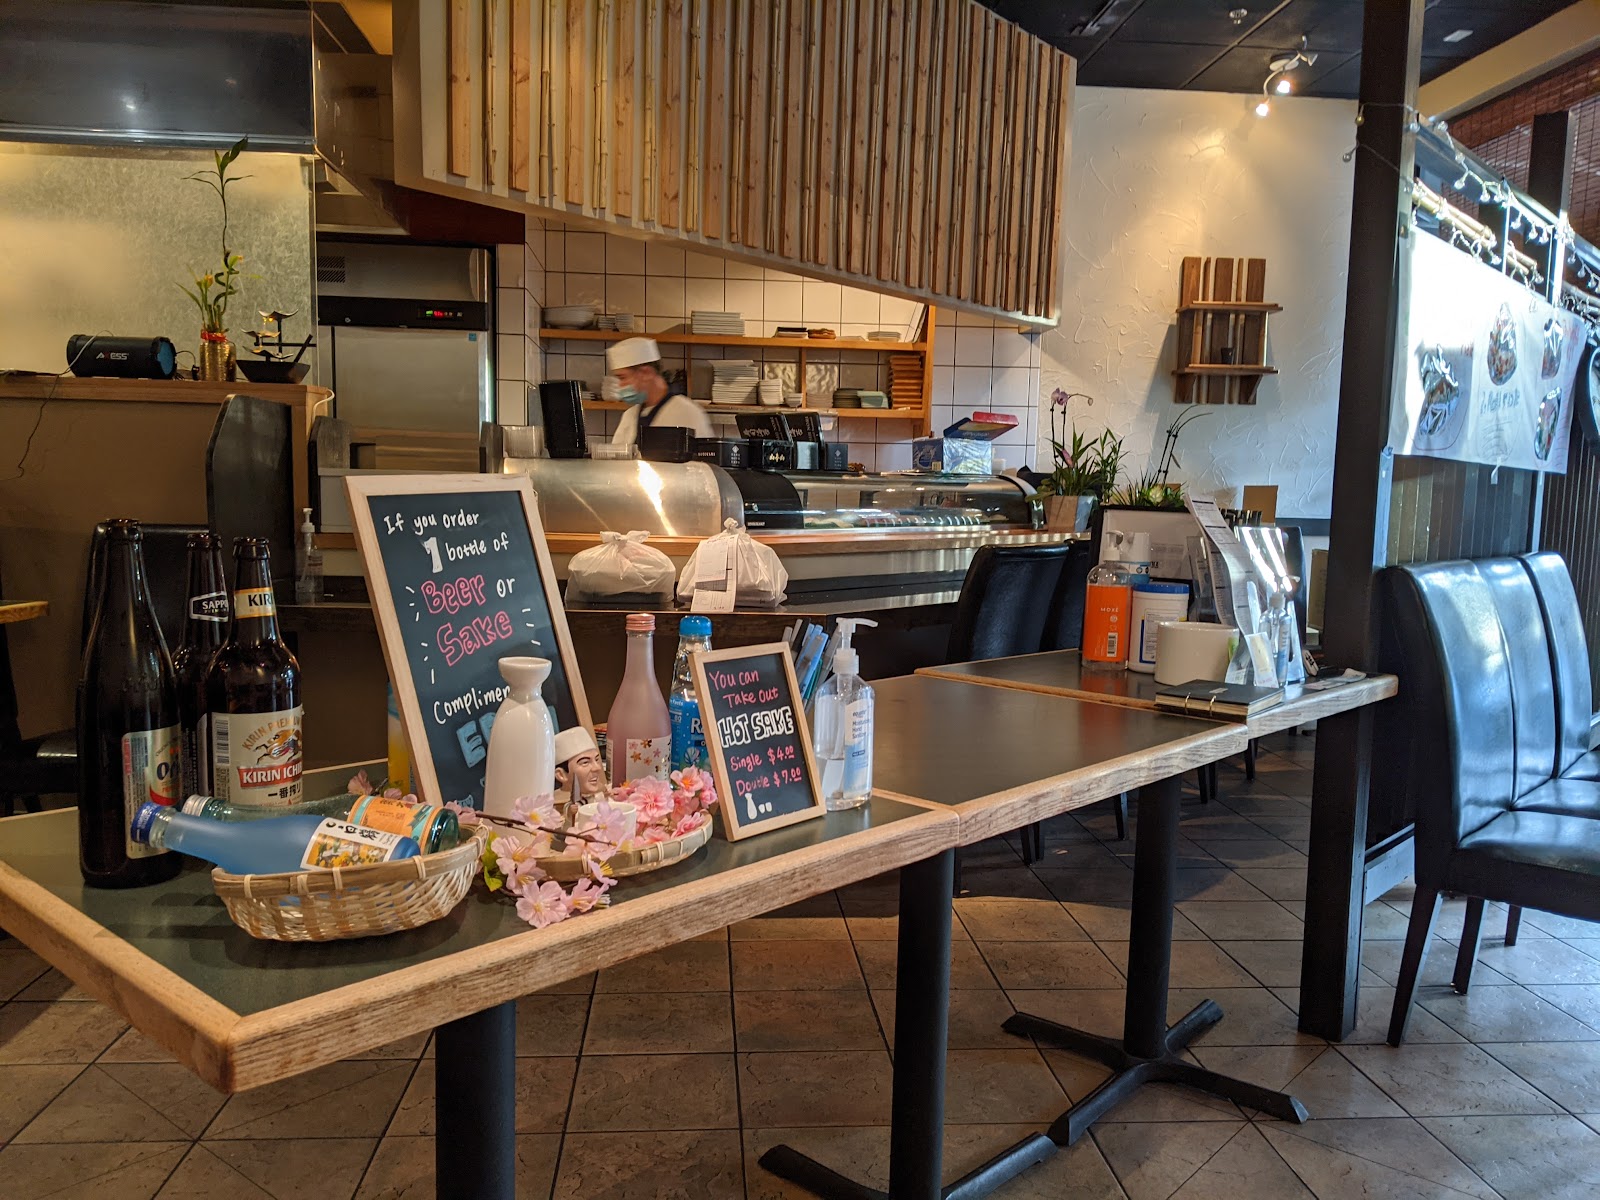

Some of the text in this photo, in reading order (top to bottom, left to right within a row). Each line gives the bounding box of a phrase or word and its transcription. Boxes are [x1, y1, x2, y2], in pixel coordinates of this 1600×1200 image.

[384, 509, 480, 536] If you order
[423, 532, 509, 573] 1 bottle of
[421, 575, 516, 615] Beer or
[437, 611, 514, 667] Sake
[709, 669, 760, 691] You can
[723, 686, 779, 708] Take Out
[751, 706, 795, 741] SAKE
[243, 769, 281, 784] KIRIN
[730, 753, 763, 773] Single
